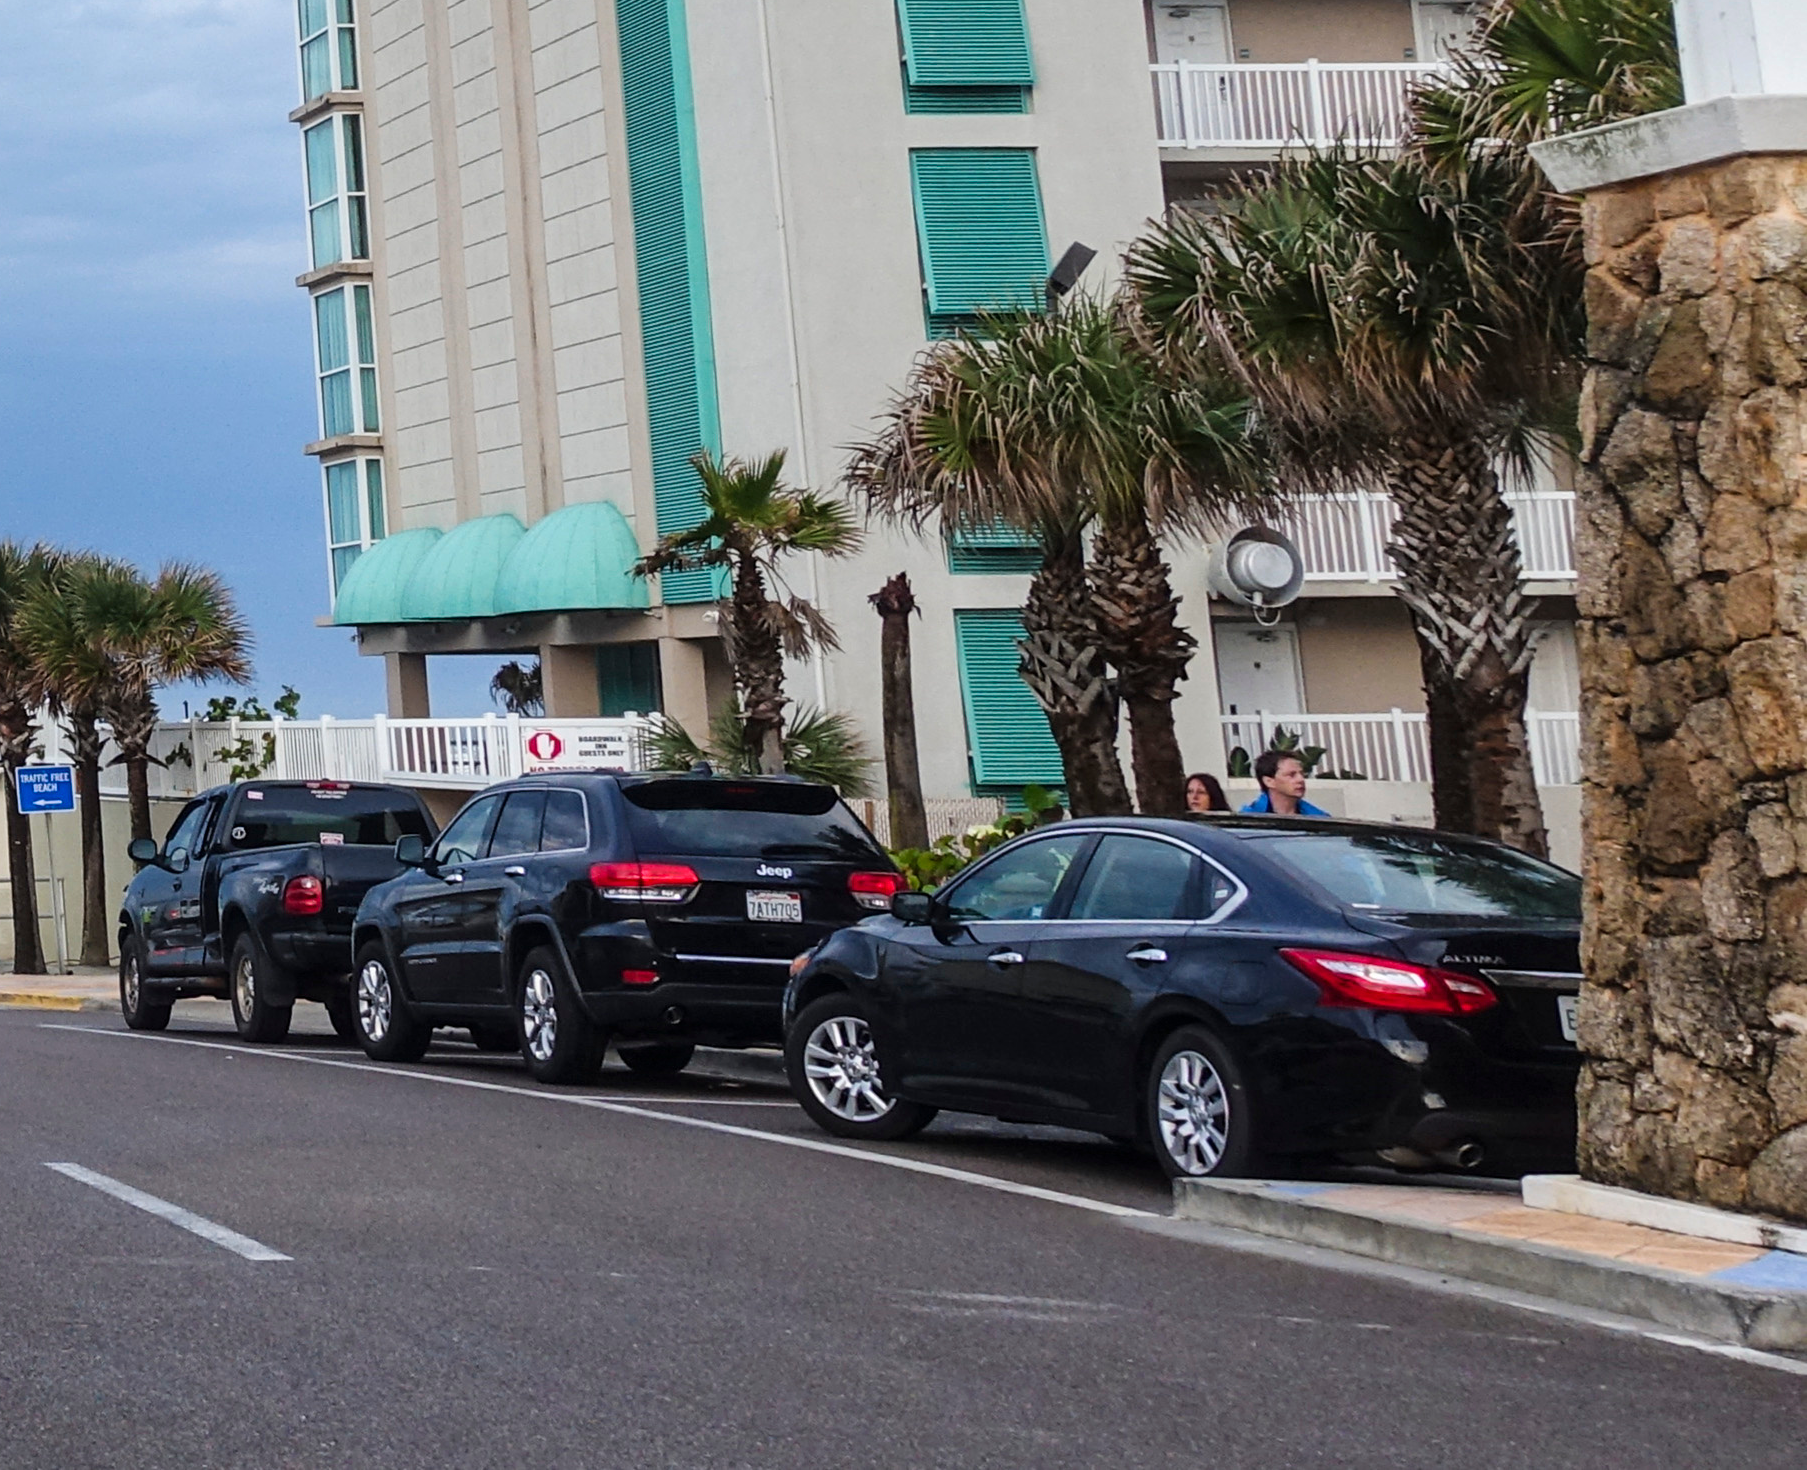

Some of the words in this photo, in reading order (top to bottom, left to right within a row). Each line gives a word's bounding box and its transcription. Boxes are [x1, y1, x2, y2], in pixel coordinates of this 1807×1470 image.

[20, 773, 49, 783] TRAFFIC
[50, 772, 70, 781] FREE
[33, 783, 58, 792] BEACH
[756, 863, 792, 879] Jeep
[749, 901, 800, 918] 7ATH705
[1443, 954, 1506, 964] ALTIMA
